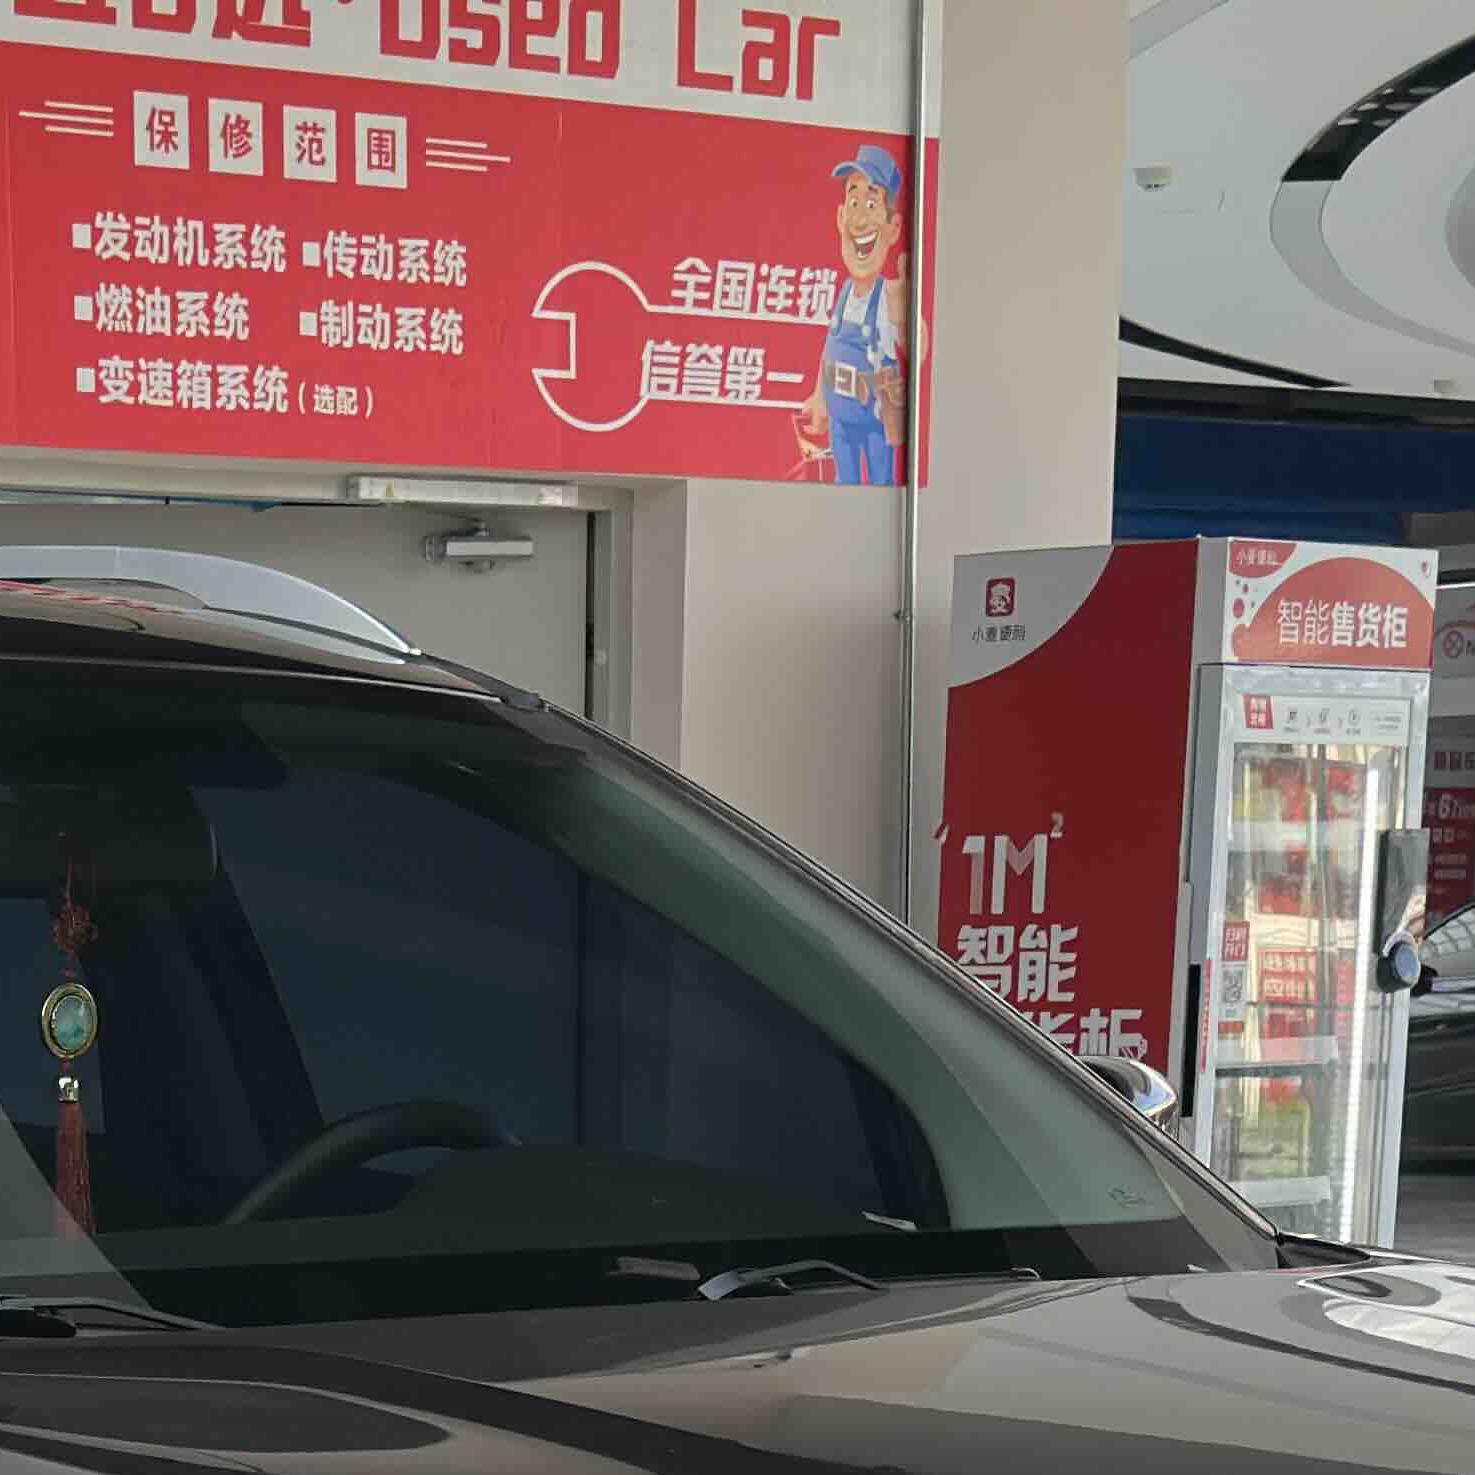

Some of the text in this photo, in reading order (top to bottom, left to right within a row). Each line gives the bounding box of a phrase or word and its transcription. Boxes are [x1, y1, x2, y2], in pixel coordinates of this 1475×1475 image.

[143, 102, 399, 173] 保修范围
[93, 212, 469, 290] 发动机系统 传动系统
[96, 281, 466, 356] 燃油系统 制动系统
[669, 256, 840, 321] 全国连锁
[639, 338, 807, 406] 信誉第一
[1277, 599, 1410, 648] 智能售货柜
